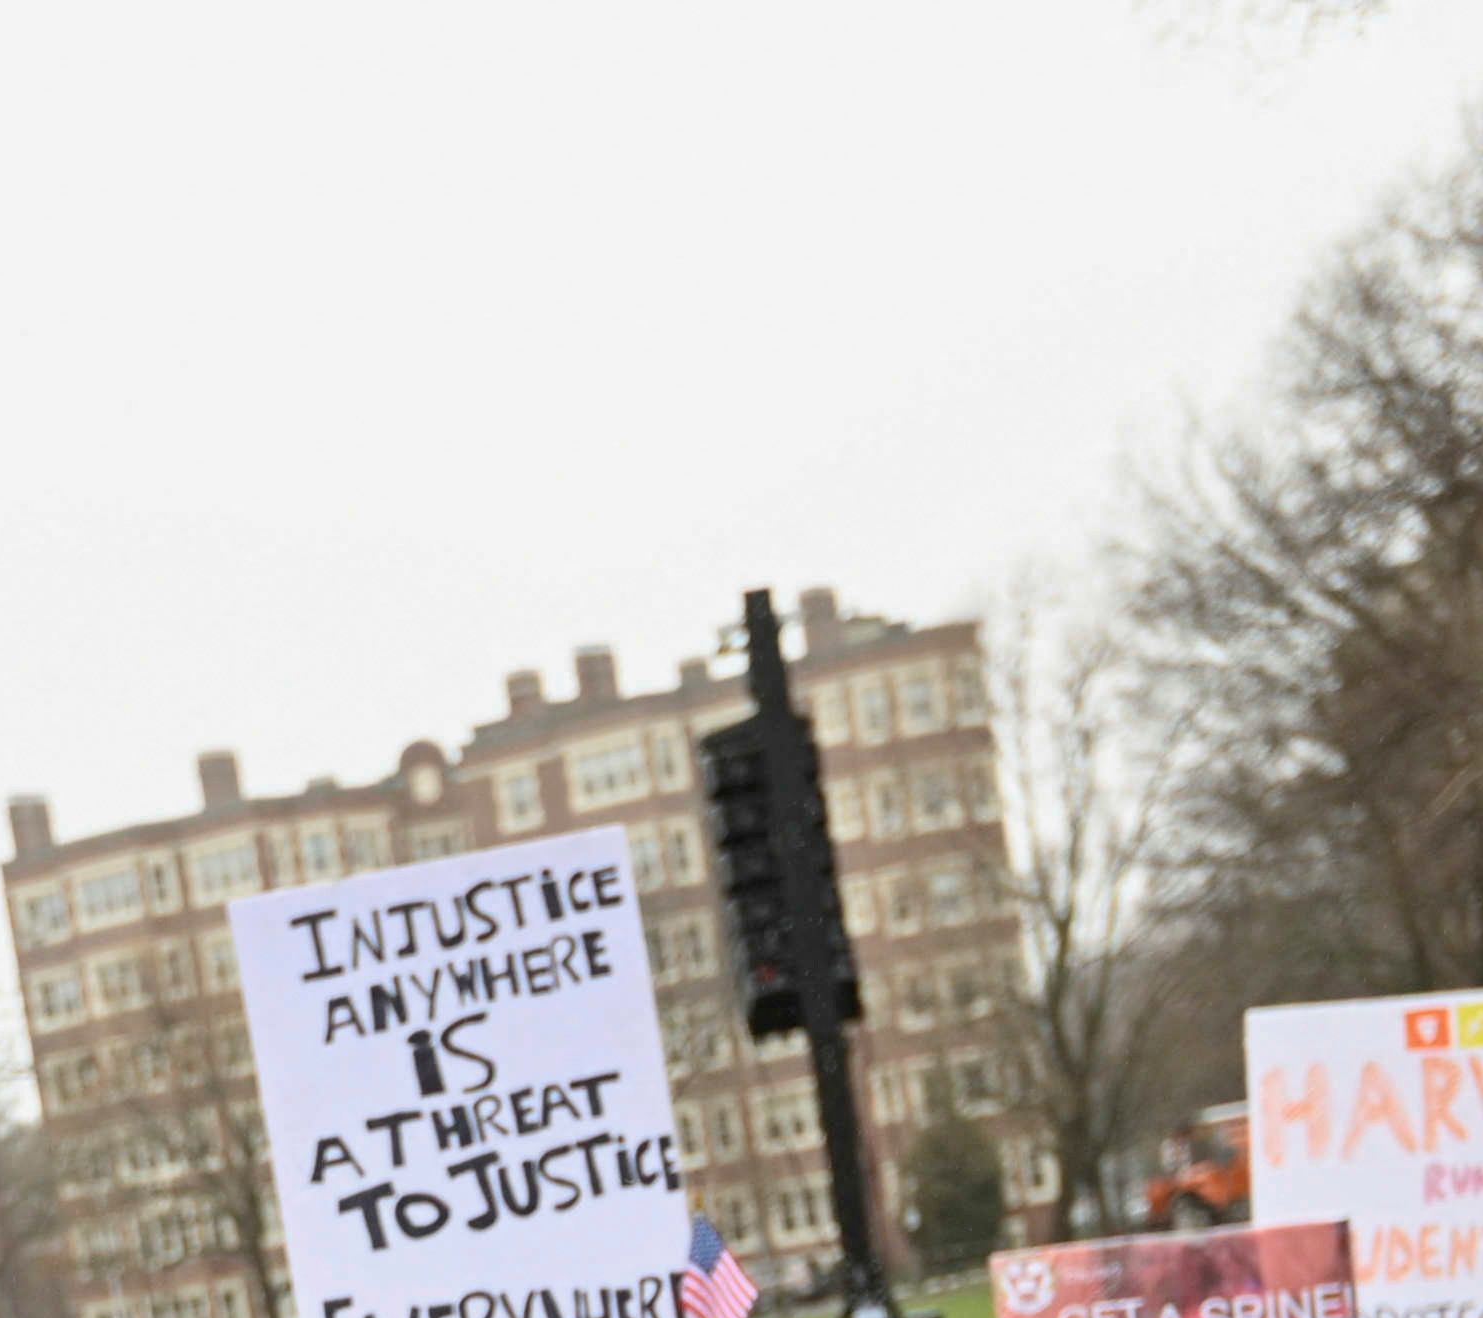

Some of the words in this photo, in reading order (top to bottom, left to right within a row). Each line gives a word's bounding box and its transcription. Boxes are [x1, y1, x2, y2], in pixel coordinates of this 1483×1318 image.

[324, 930, 612, 1043] ANYWHERE
[310, 1138, 364, 1184] A
[367, 1073, 621, 1167] THREAT
[338, 1180, 450, 1250] TO
